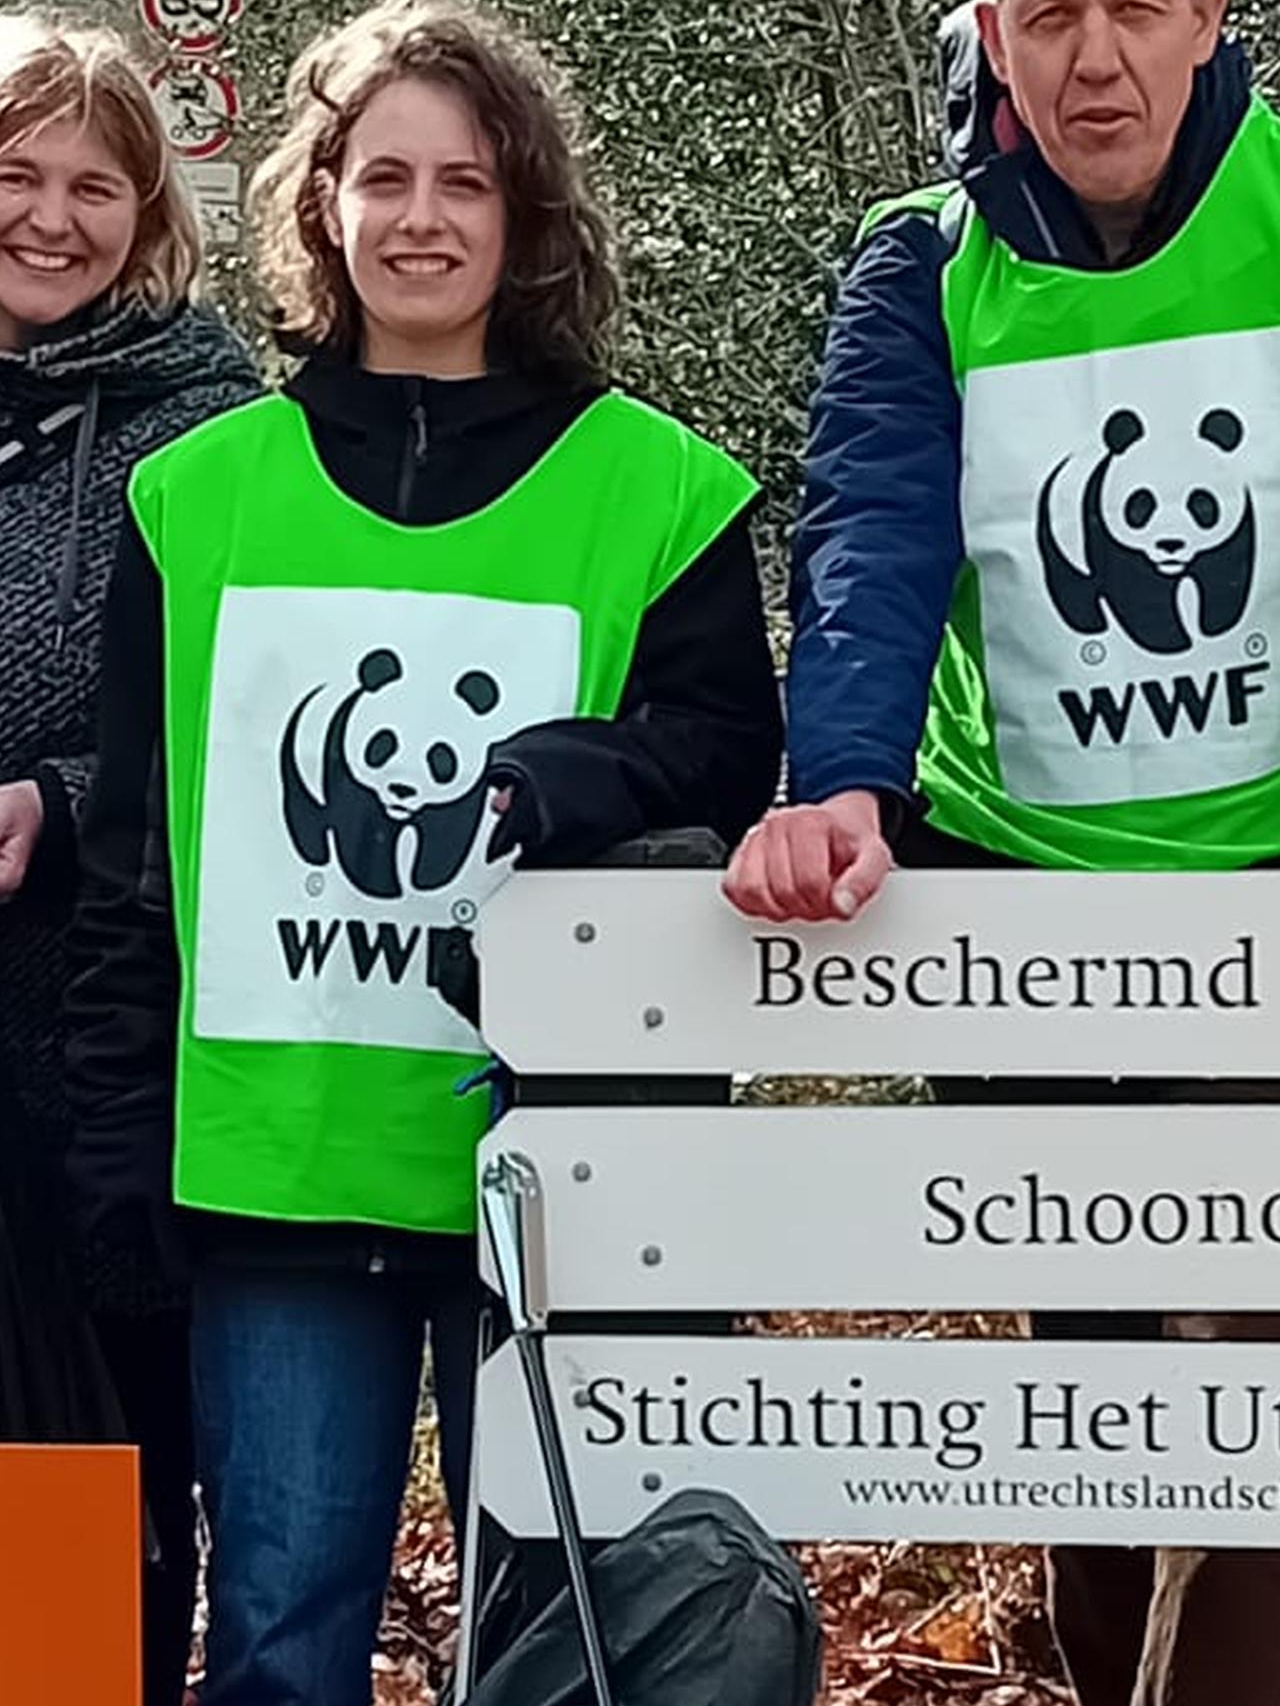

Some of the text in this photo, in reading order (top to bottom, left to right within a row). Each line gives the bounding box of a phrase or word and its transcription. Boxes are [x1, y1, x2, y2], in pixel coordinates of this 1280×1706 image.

[1058, 661, 1271, 748] WWF
[751, 935, 1260, 1009] Beschermd
[584, 1375, 986, 1470] Stichting
[1016, 1382, 1169, 1453] Het
